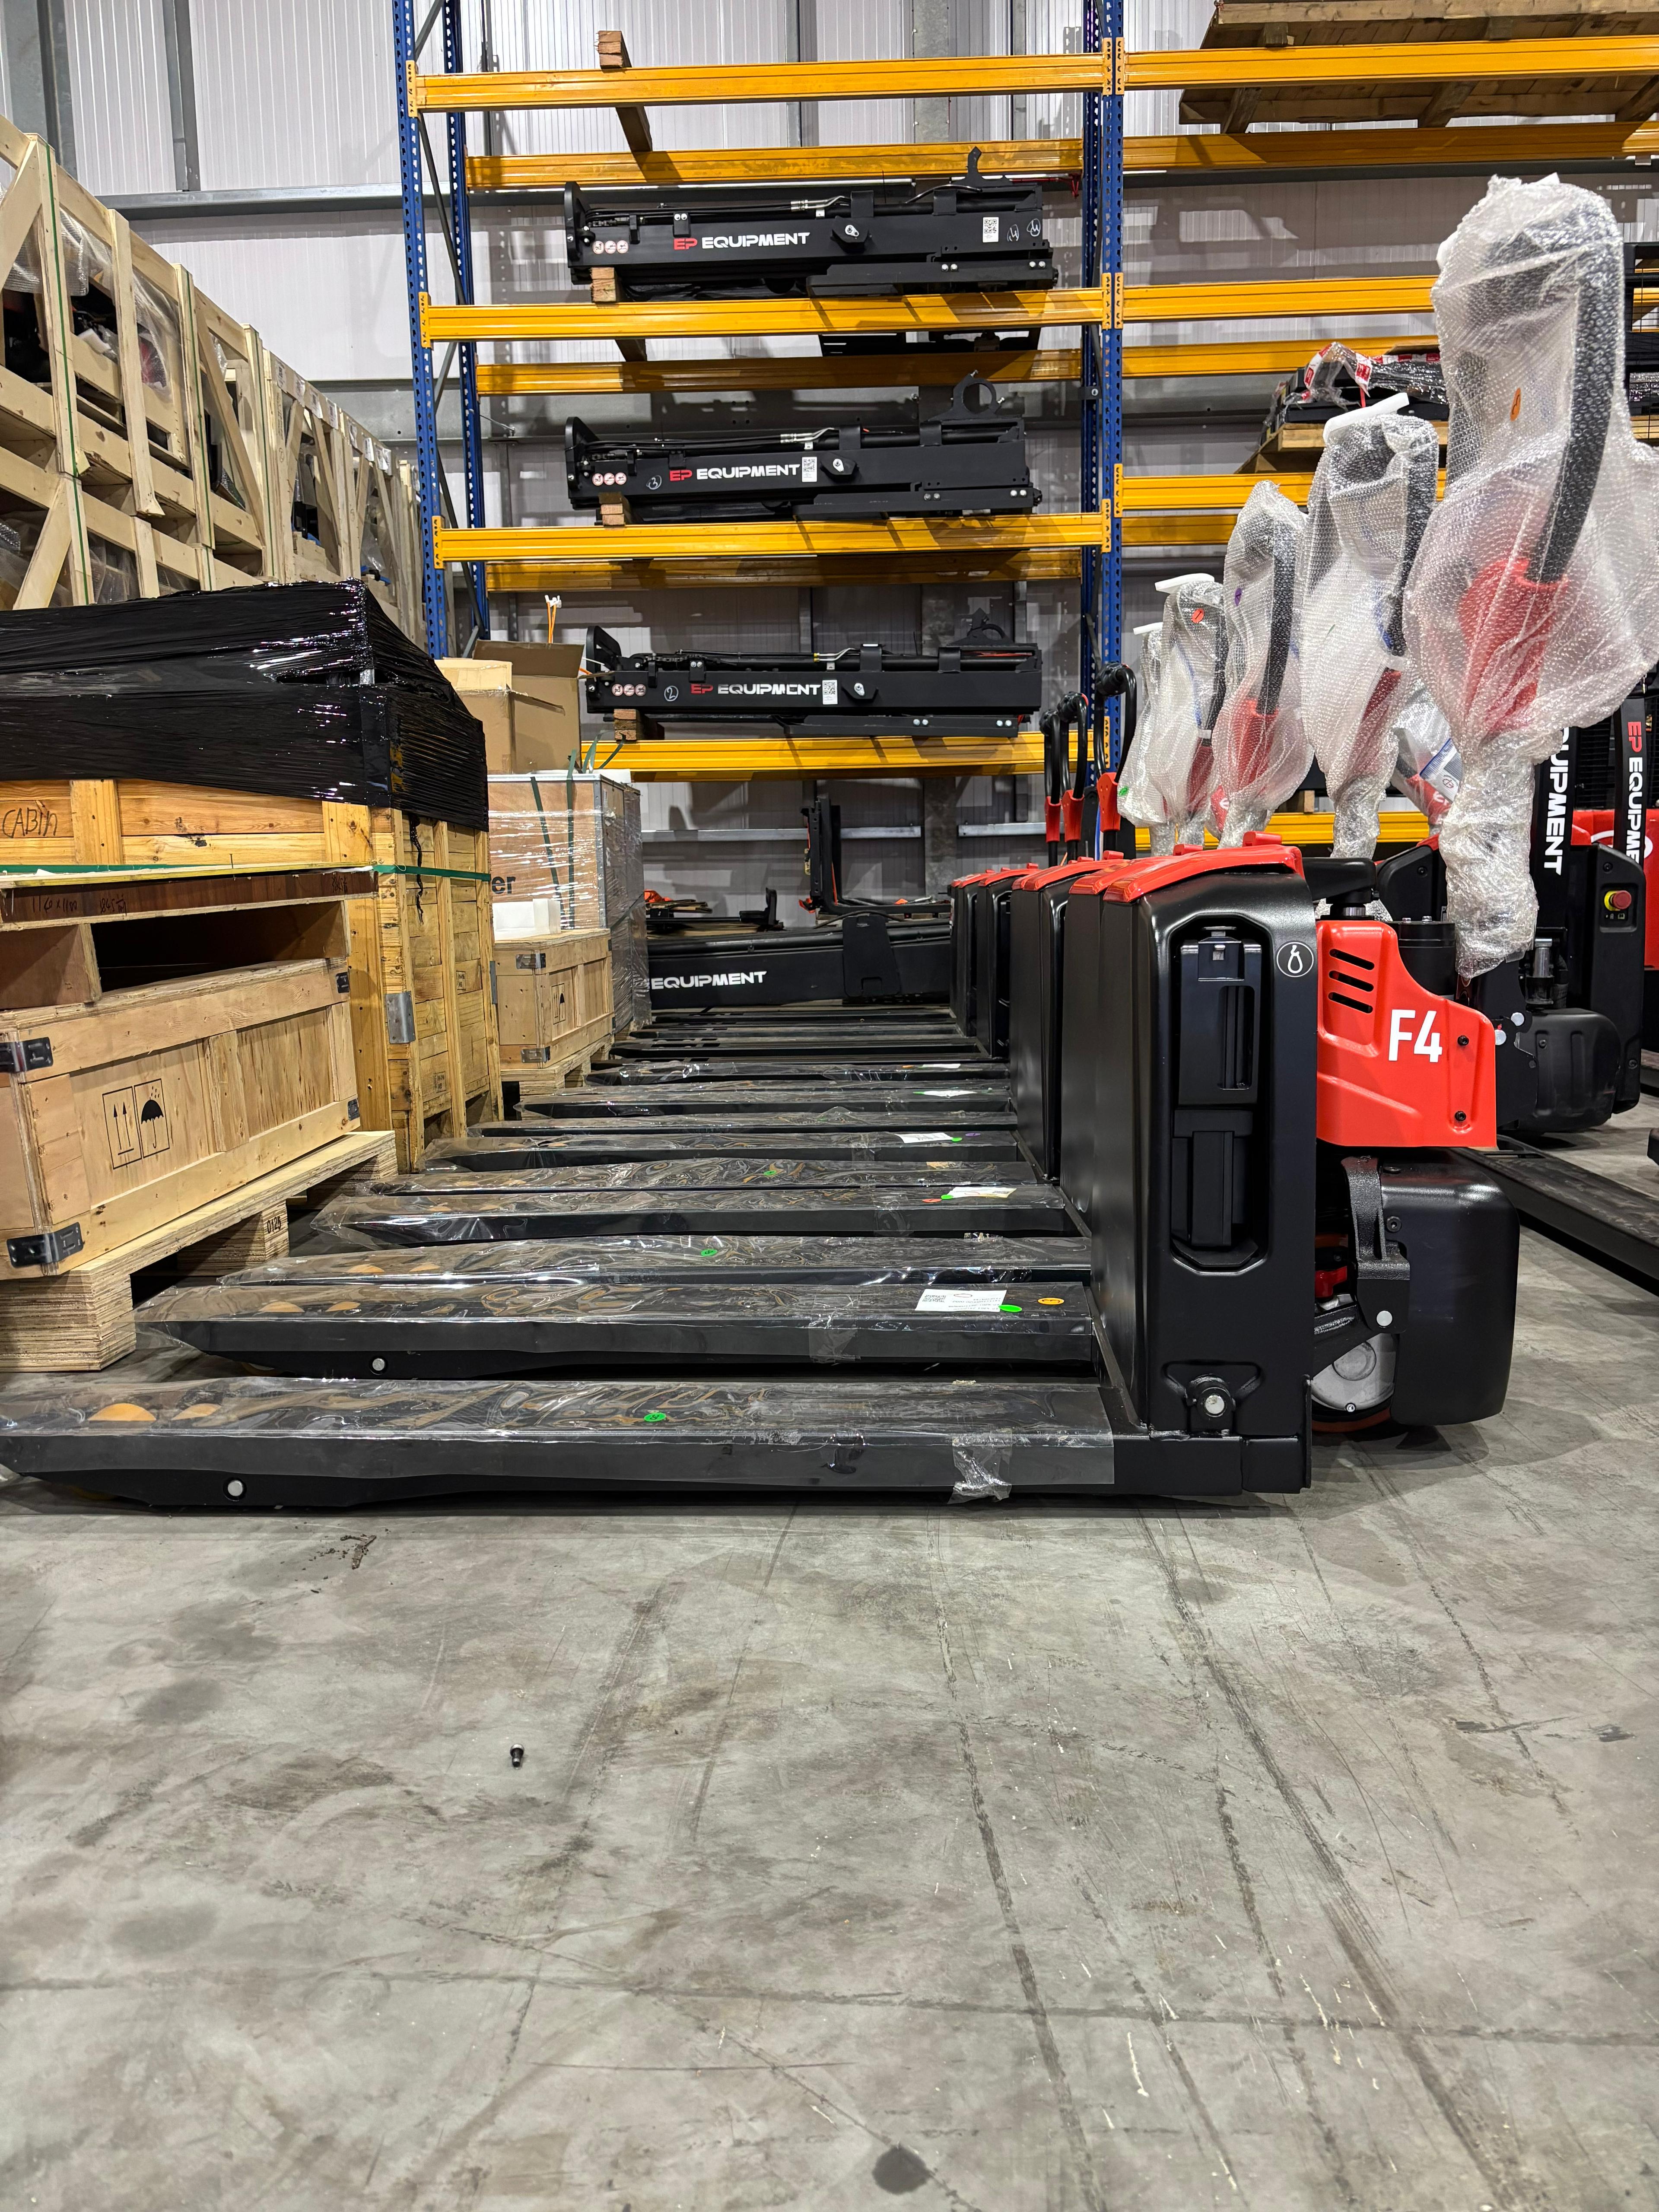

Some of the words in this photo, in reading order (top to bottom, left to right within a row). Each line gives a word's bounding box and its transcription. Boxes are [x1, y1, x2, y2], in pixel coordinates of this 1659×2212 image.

[673, 238, 697, 251] EP
[702, 232, 810, 248] EQUIPMENT
[669, 469, 693, 482] EP
[697, 464, 800, 480] EQUIPMENT
[690, 683, 714, 694] EP
[718, 683, 821, 695] EQUIPMENT
[1627, 721, 1643, 753] EP
[1543, 727, 1570, 876] UIPMENT
[491, 876, 516, 894] er
[651, 971, 767, 990] EQUIPMENT
[1388, 1009, 1443, 1063] F4
[267, 1215, 282, 1234] 0125
